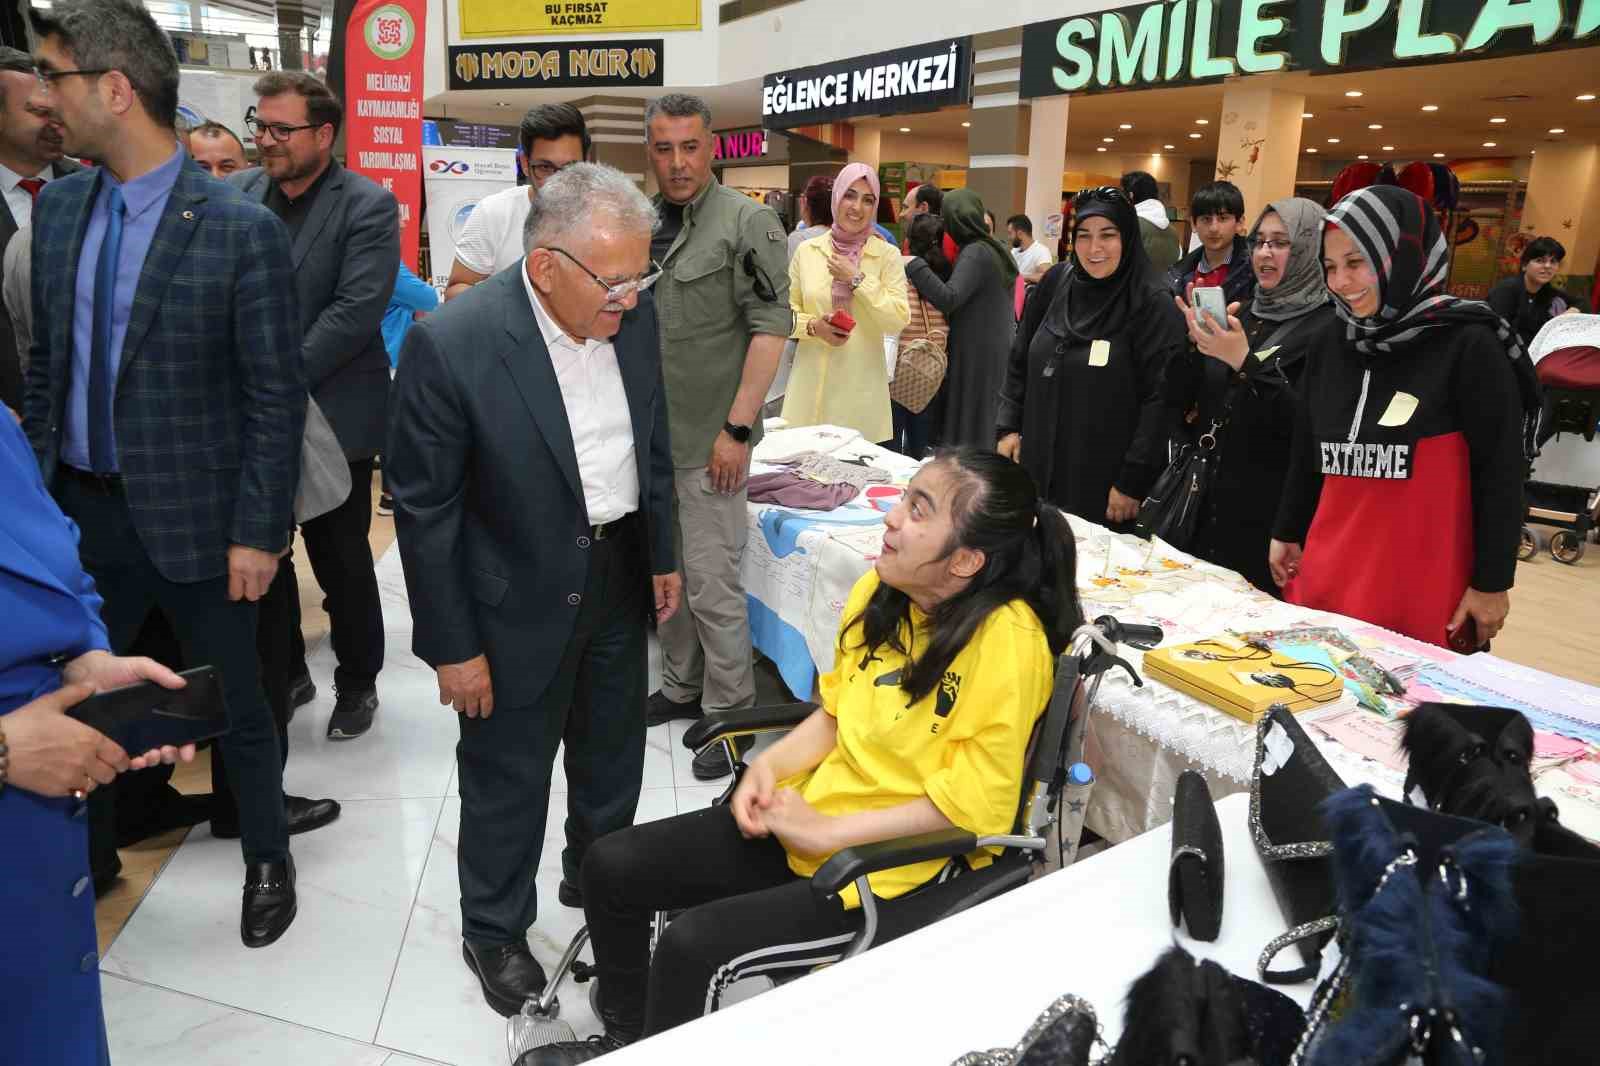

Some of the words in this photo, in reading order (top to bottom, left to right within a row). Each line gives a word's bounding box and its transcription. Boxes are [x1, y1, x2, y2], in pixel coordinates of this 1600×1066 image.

[545, 4, 561, 14] BU
[565, 2, 608, 13] FIRSAT
[551, 14, 602, 26] KAÇMAZ
[1053, 0, 1284, 90] SMILE
[1321, 0, 1600, 65] PLA
[482, 50, 560, 80] MODA
[569, 48, 630, 79] NUR
[367, 70, 411, 92] MELİKGAZİ
[763, 73, 848, 115] EĞLENCE
[852, 42, 957, 102] MERKEZİ
[358, 98, 419, 119] KAYMAKAMLIĞI
[373, 125, 403, 144] SOSYAL
[726, 130, 762, 160] NUR
[359, 151, 417, 172] YARDIMLAŞMA
[1320, 441, 1409, 479] EXTREME
